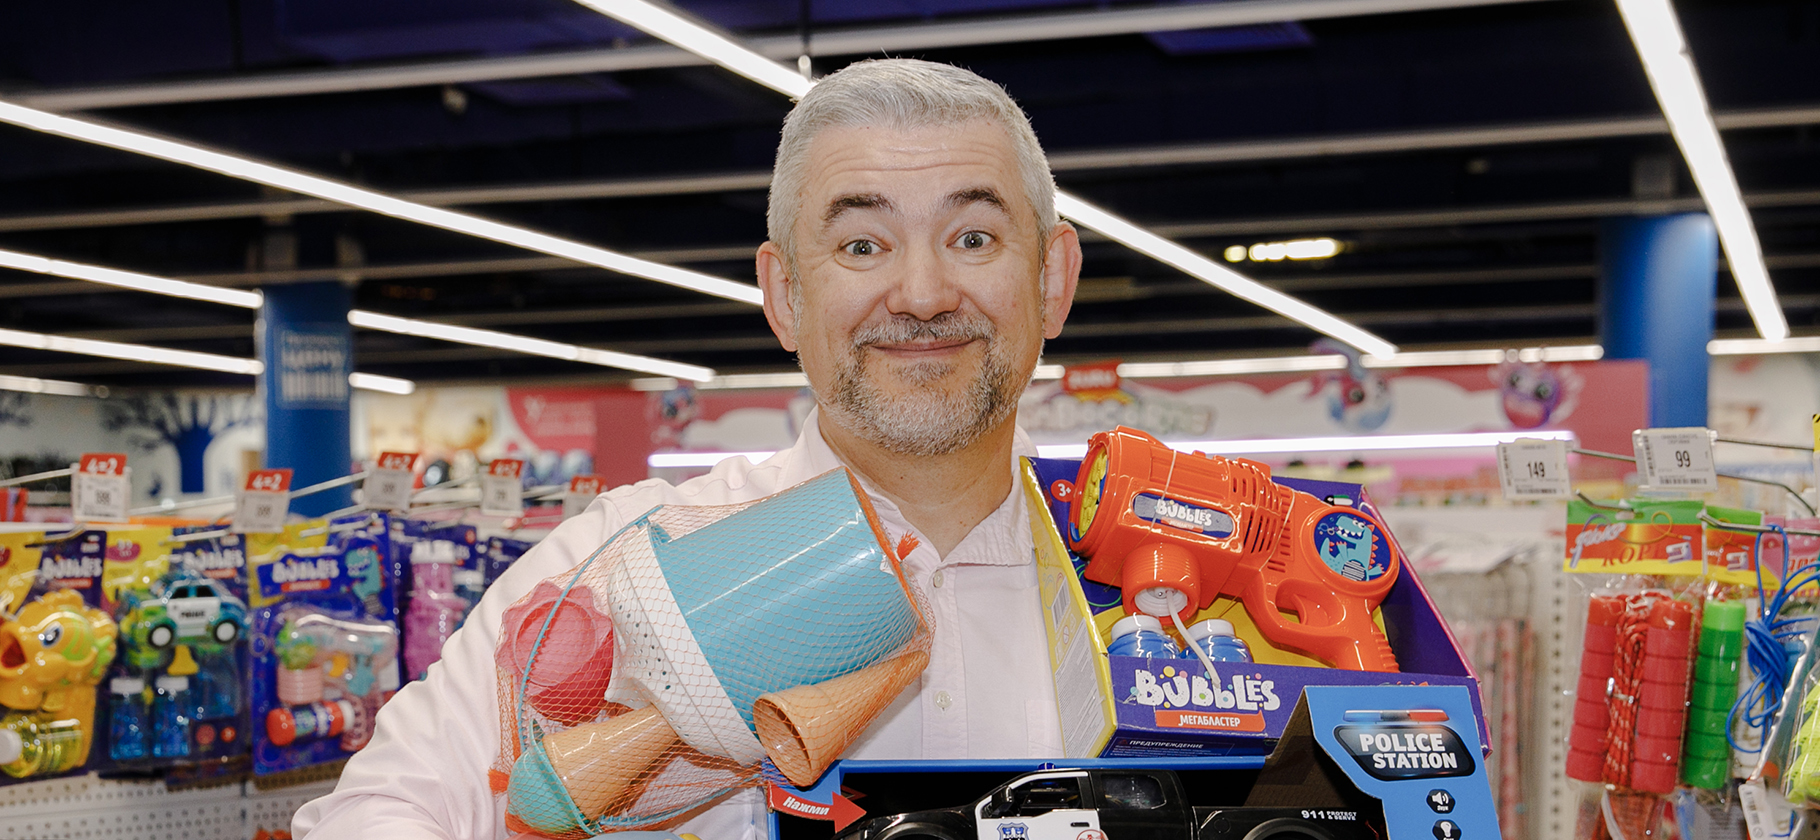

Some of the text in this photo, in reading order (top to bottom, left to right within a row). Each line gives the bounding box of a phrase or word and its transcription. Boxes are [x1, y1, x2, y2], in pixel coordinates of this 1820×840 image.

[1675, 450, 1691, 468] 99
[1526, 461, 1545, 478] 149
[1057, 483, 1071, 497] 3+
[1178, 714, 1241, 727] МЕГАБЛАСТЕР
[1129, 740, 1204, 749] ПРЕДУПРЕЖДЕНИЕ
[1359, 733, 1446, 752] POLICE
[1372, 752, 1458, 769] STATION
[783, 796, 829, 815] Нажми
[1301, 810, 1325, 819] 911
